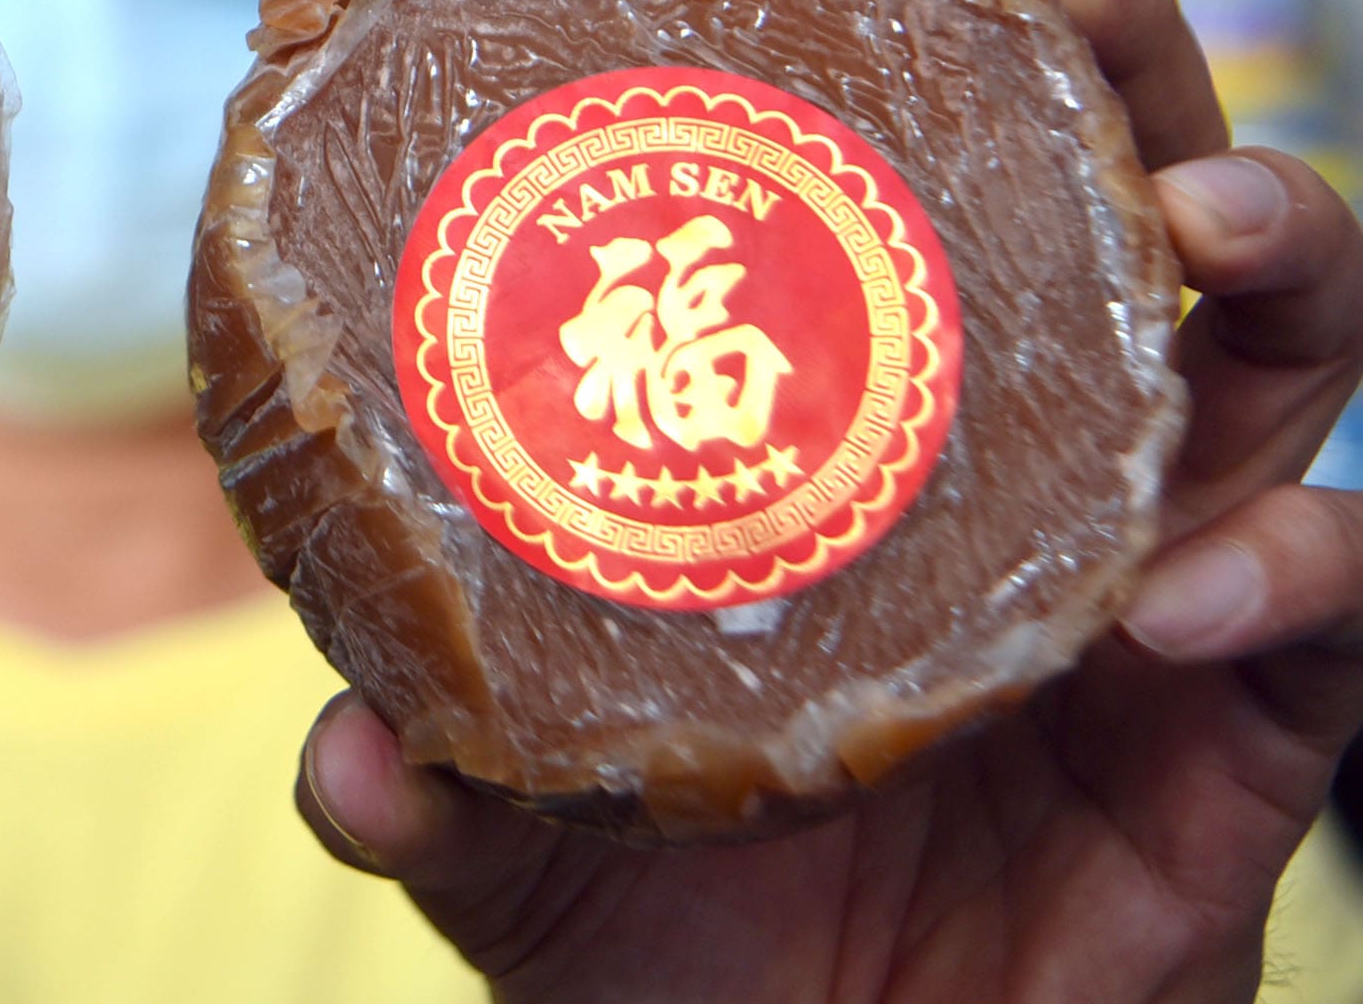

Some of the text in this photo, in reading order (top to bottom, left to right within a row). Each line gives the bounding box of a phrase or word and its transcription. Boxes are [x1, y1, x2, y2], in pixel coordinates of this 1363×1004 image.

[537, 162, 782, 244] NAM SEN
[559, 215, 793, 451] 福
